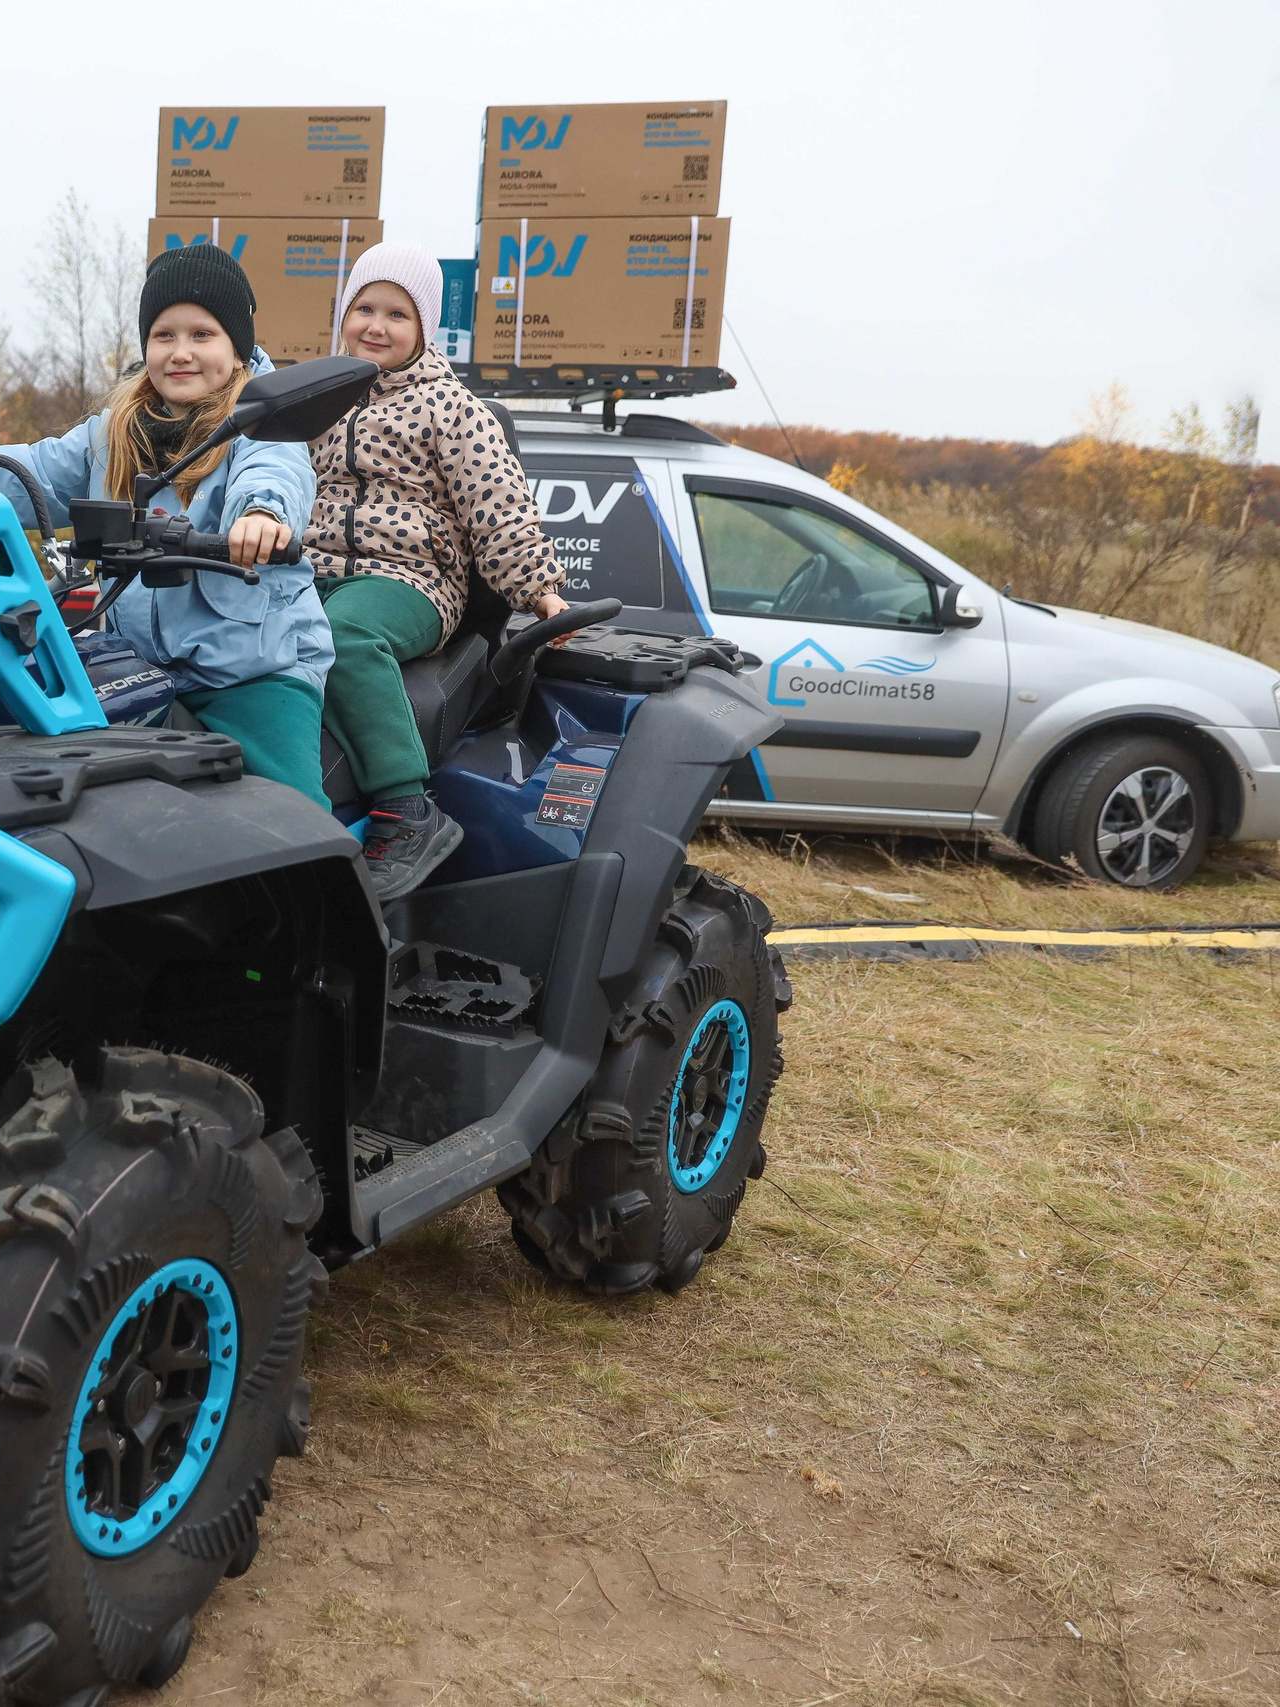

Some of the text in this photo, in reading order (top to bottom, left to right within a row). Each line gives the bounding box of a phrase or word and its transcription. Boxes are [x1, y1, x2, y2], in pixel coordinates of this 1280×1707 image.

[172, 116, 240, 150] MDV
[500, 115, 573, 150] MDV
[171, 169, 211, 177] AURORA
[500, 170, 543, 179] AURORA
[629, 233, 712, 242] КОНДИЦИОНРЫ
[498, 234, 588, 277] MDV
[552, 537, 601, 552] СКОЕ
[556, 556, 593, 571] НИЕ
[789, 677, 935, 701] GoodClimat58
